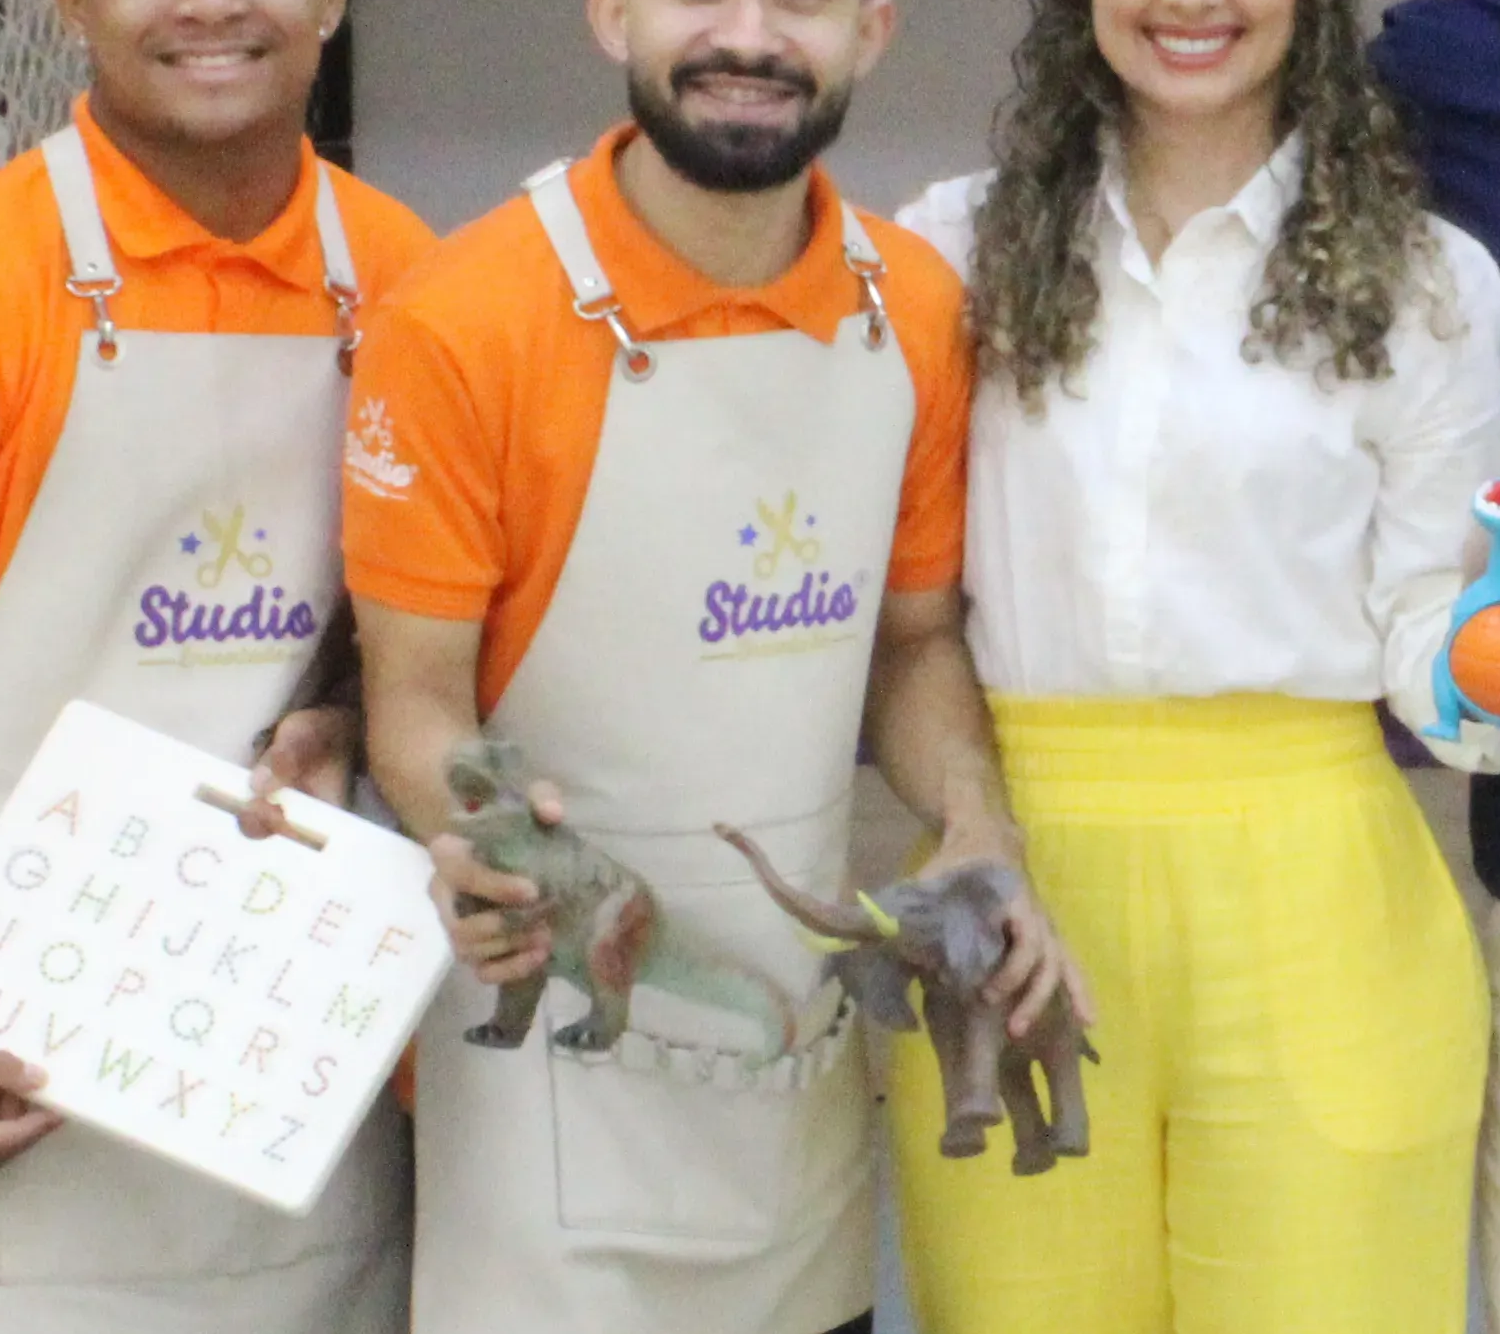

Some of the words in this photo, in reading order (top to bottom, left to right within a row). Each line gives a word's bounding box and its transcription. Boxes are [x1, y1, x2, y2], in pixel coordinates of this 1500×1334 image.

[135, 584, 316, 648] Studio
[699, 572, 857, 643] Studio
[5, 849, 51, 890] G
[68, 874, 120, 924] H
[128, 899, 154, 938] I
[162, 920, 203, 956] J
[212, 934, 259, 984] K
[267, 958, 293, 1008] L
[322, 983, 380, 1038] M
[37, 789, 80, 836] A
[109, 815, 149, 858] B
[177, 846, 222, 888] C
[241, 871, 286, 914] D
[307, 899, 351, 947] E
[367, 926, 415, 967] F
[39, 941, 85, 983] O
[104, 967, 146, 1007] P
[170, 998, 215, 1047] Q
[238, 1025, 278, 1074] R
[301, 1055, 338, 1097] S
[44, 1012, 84, 1057] V
[97, 1038, 154, 1092] W
[158, 1069, 206, 1118] X
[219, 1092, 257, 1137] Y
[262, 1114, 305, 1163] Z
